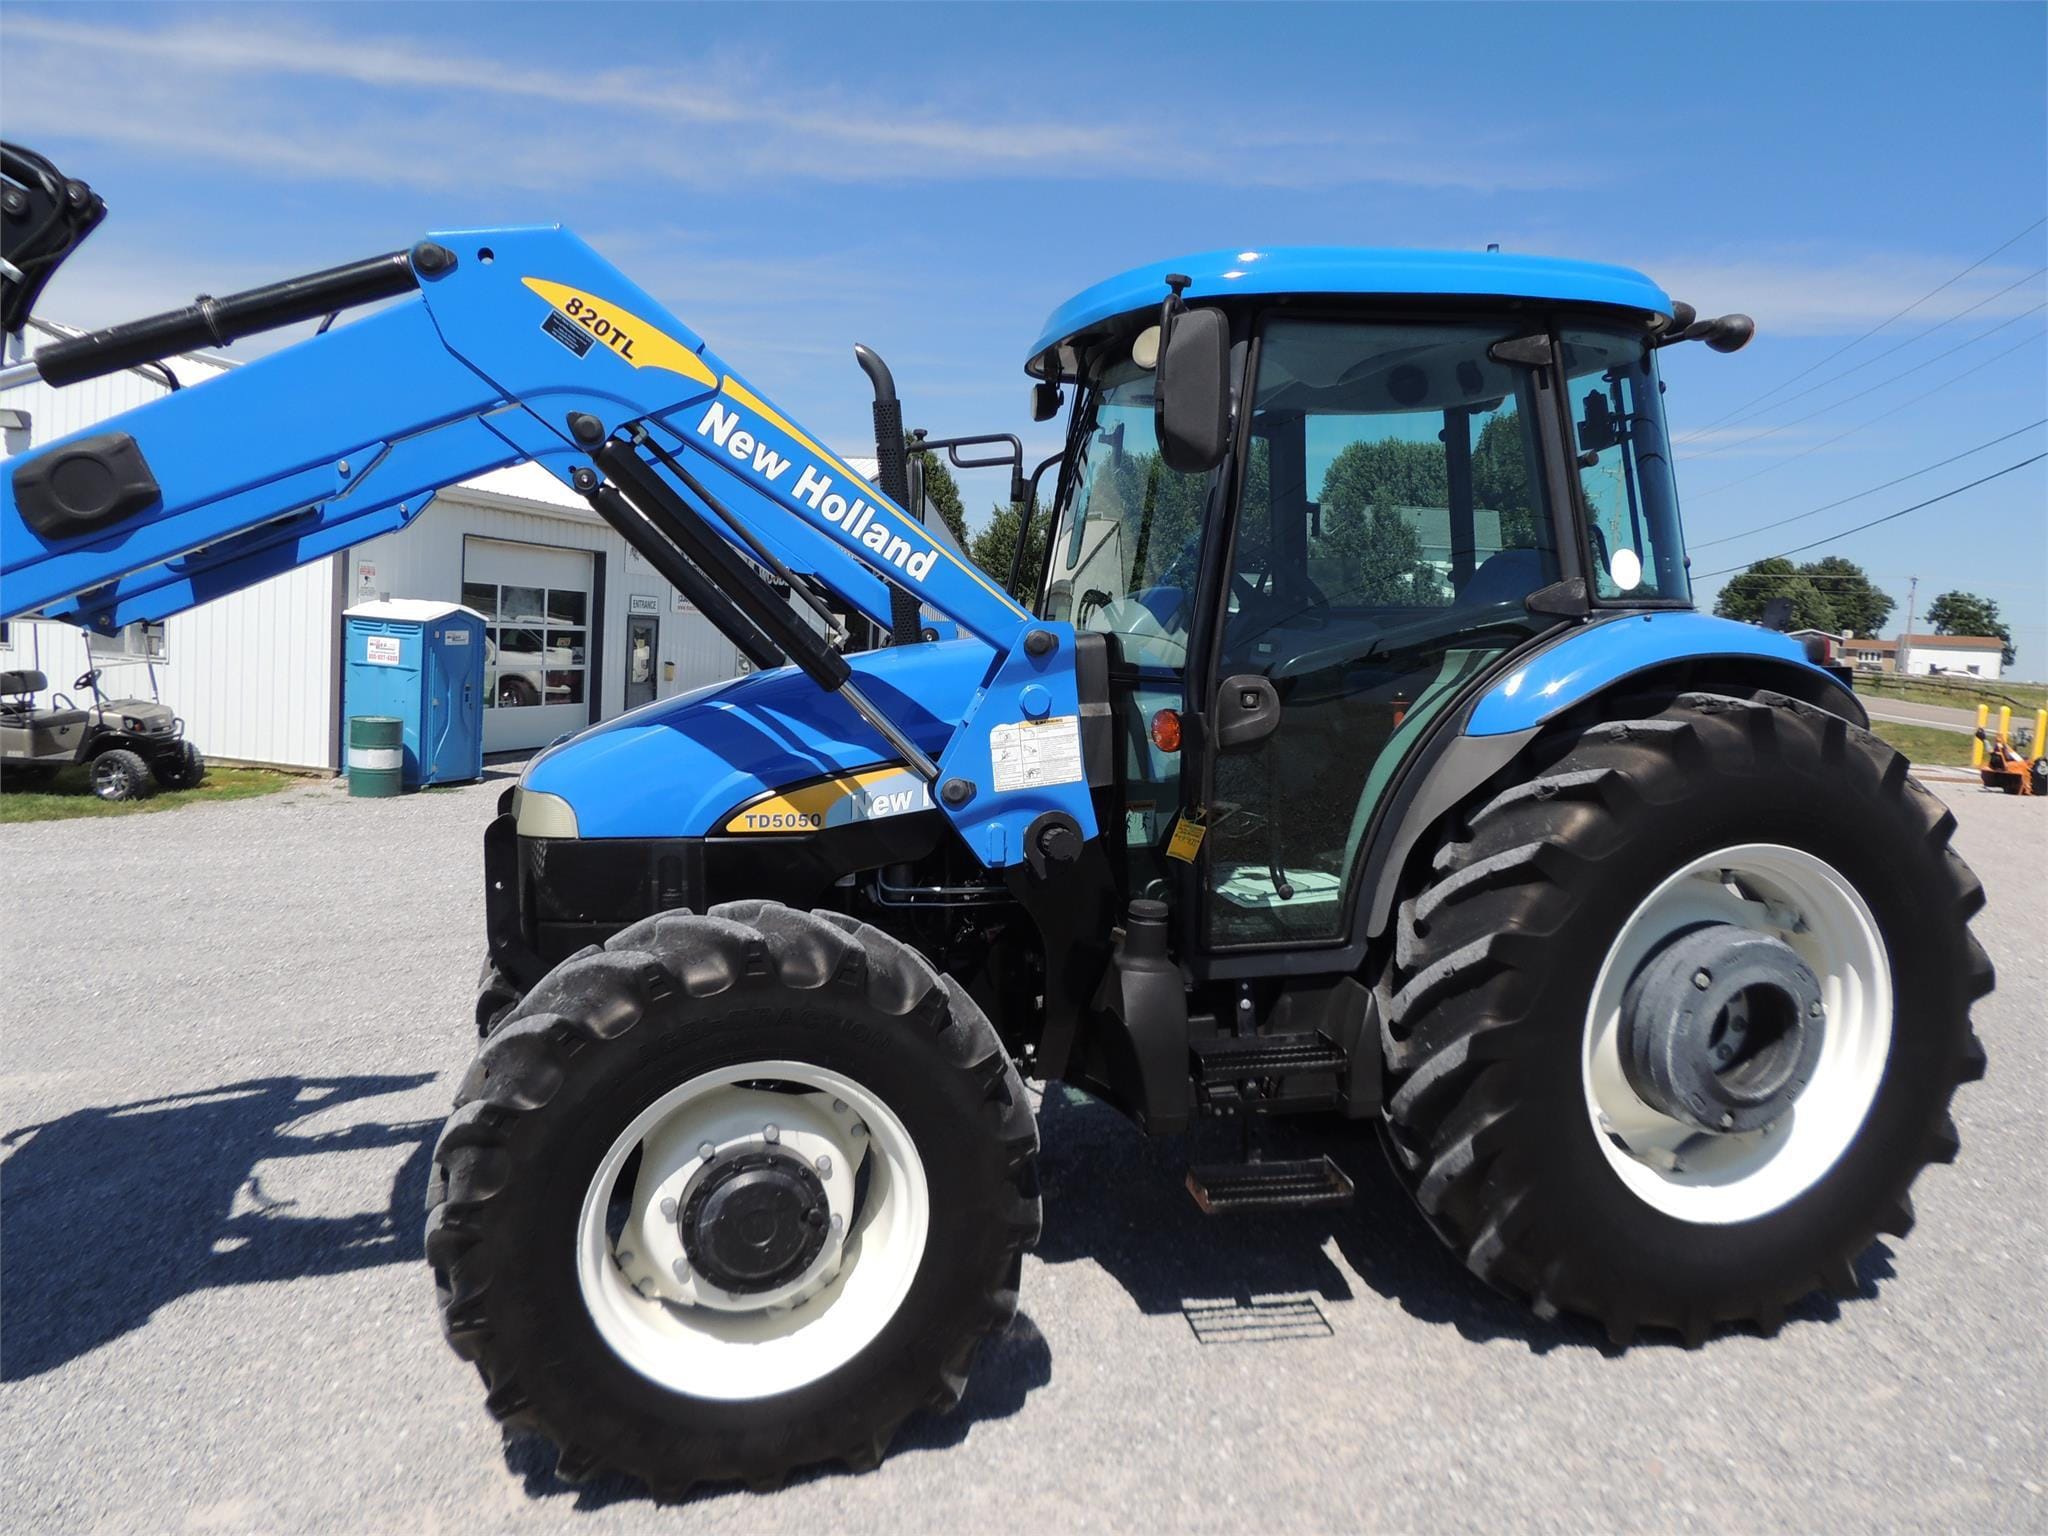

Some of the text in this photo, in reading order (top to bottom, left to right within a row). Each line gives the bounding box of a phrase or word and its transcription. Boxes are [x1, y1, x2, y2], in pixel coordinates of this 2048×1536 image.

[565, 298, 634, 360] 820TL
[697, 401, 939, 582] New Holland
[633, 600, 656, 609] ENTRANCE
[852, 789, 912, 818] New
[745, 813, 822, 828] TD5050
